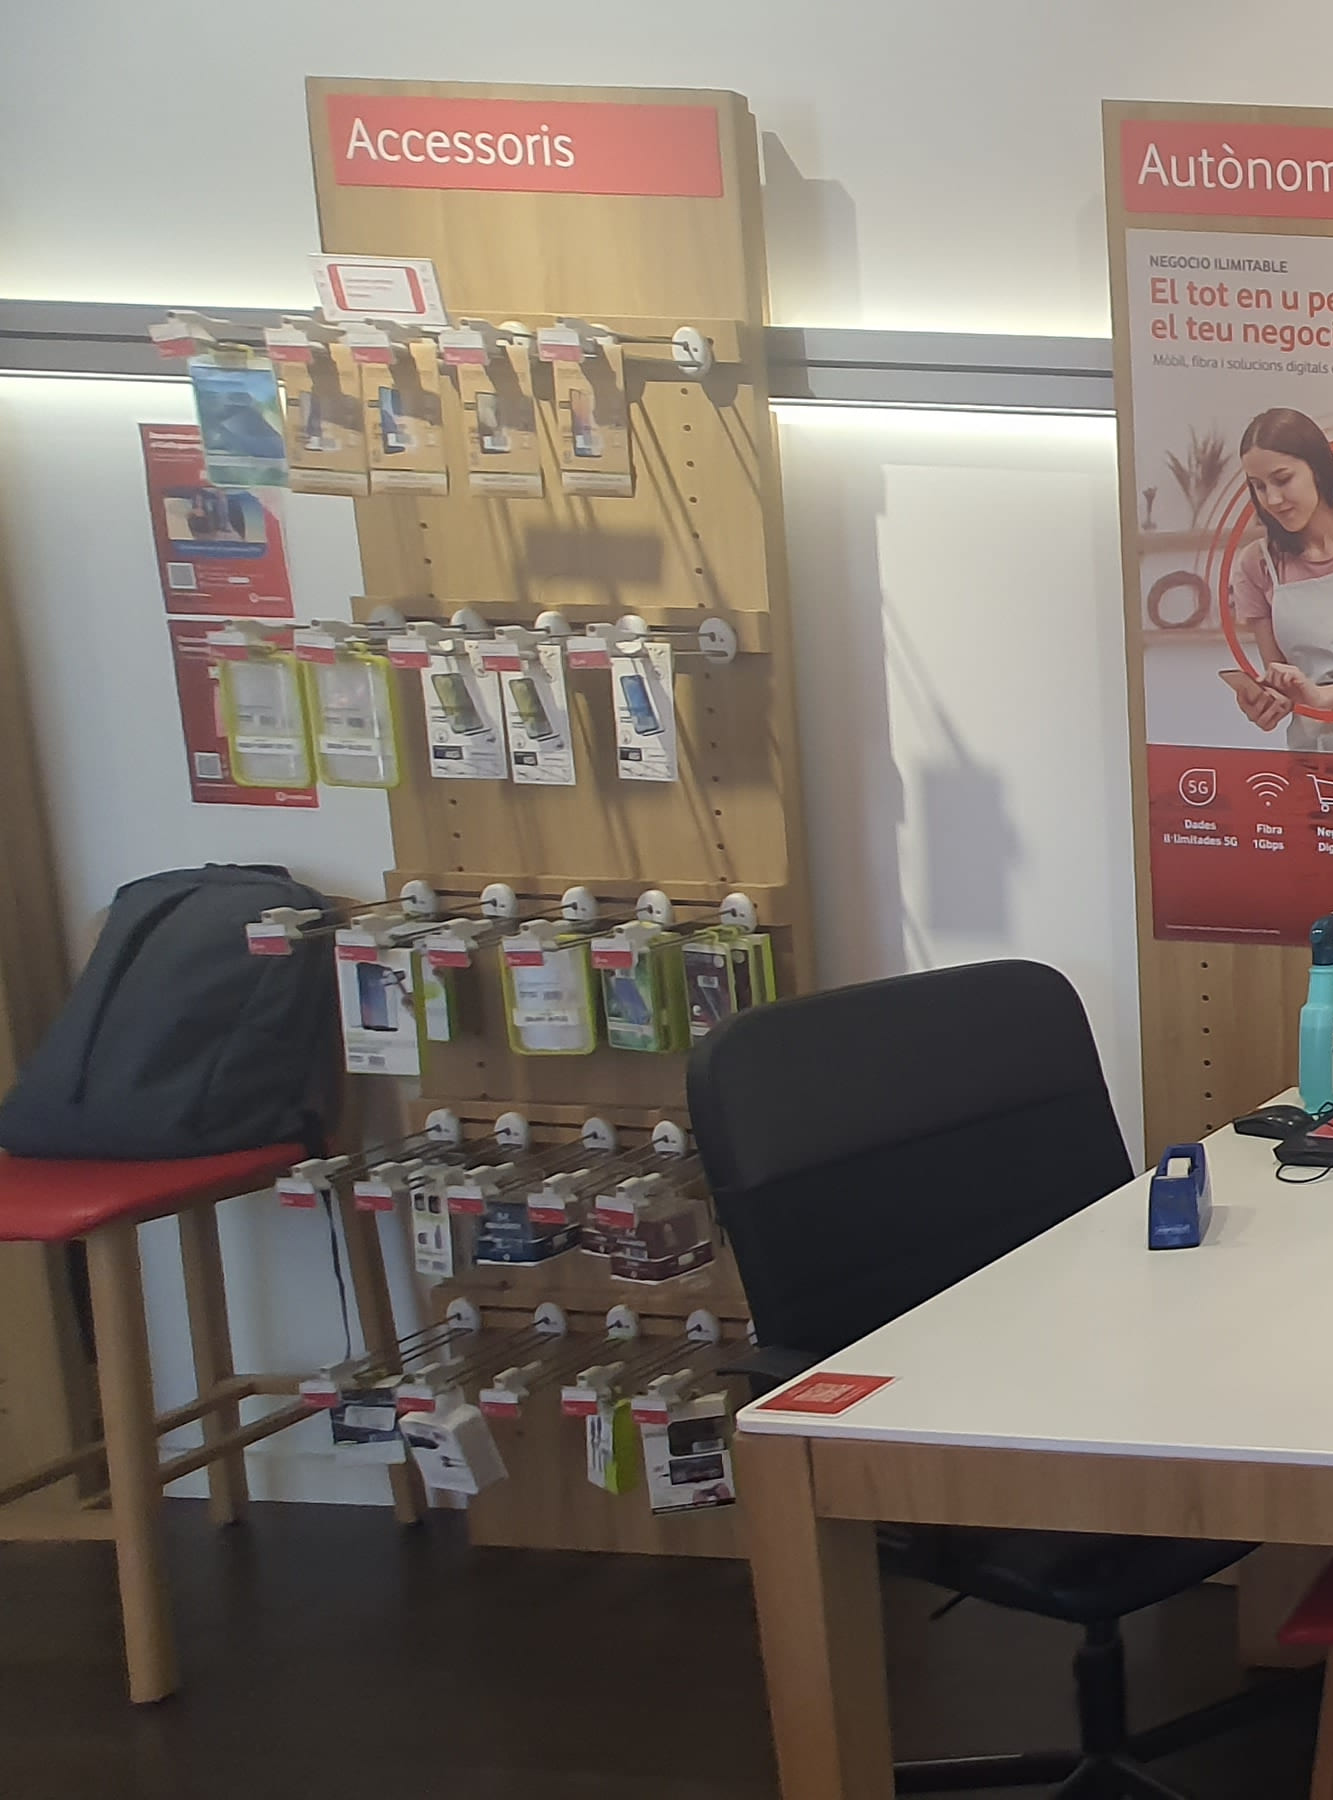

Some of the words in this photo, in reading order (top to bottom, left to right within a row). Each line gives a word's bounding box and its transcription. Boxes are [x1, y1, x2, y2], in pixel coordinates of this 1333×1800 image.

[345, 117, 575, 170] Accessoris
[1150, 255, 1211, 270] NEGOCIO
[1214, 259, 1289, 274] ILIMITABLE
[1150, 277, 1179, 305] El
[1186, 279, 1229, 307] tot
[1237, 289, 1272, 310] en
[1281, 290, 1300, 311] u
[1151, 313, 1178, 340] el
[1186, 315, 1233, 343] teu
[1227, 357, 1284, 372] solucions
[1286, 360, 1329, 376] digitals
[1188, 780, 1209, 794] 5G
[1184, 819, 1217, 831] Dades
[1256, 823, 1283, 835] Fibra
[1223, 836, 1238, 847] 5G
